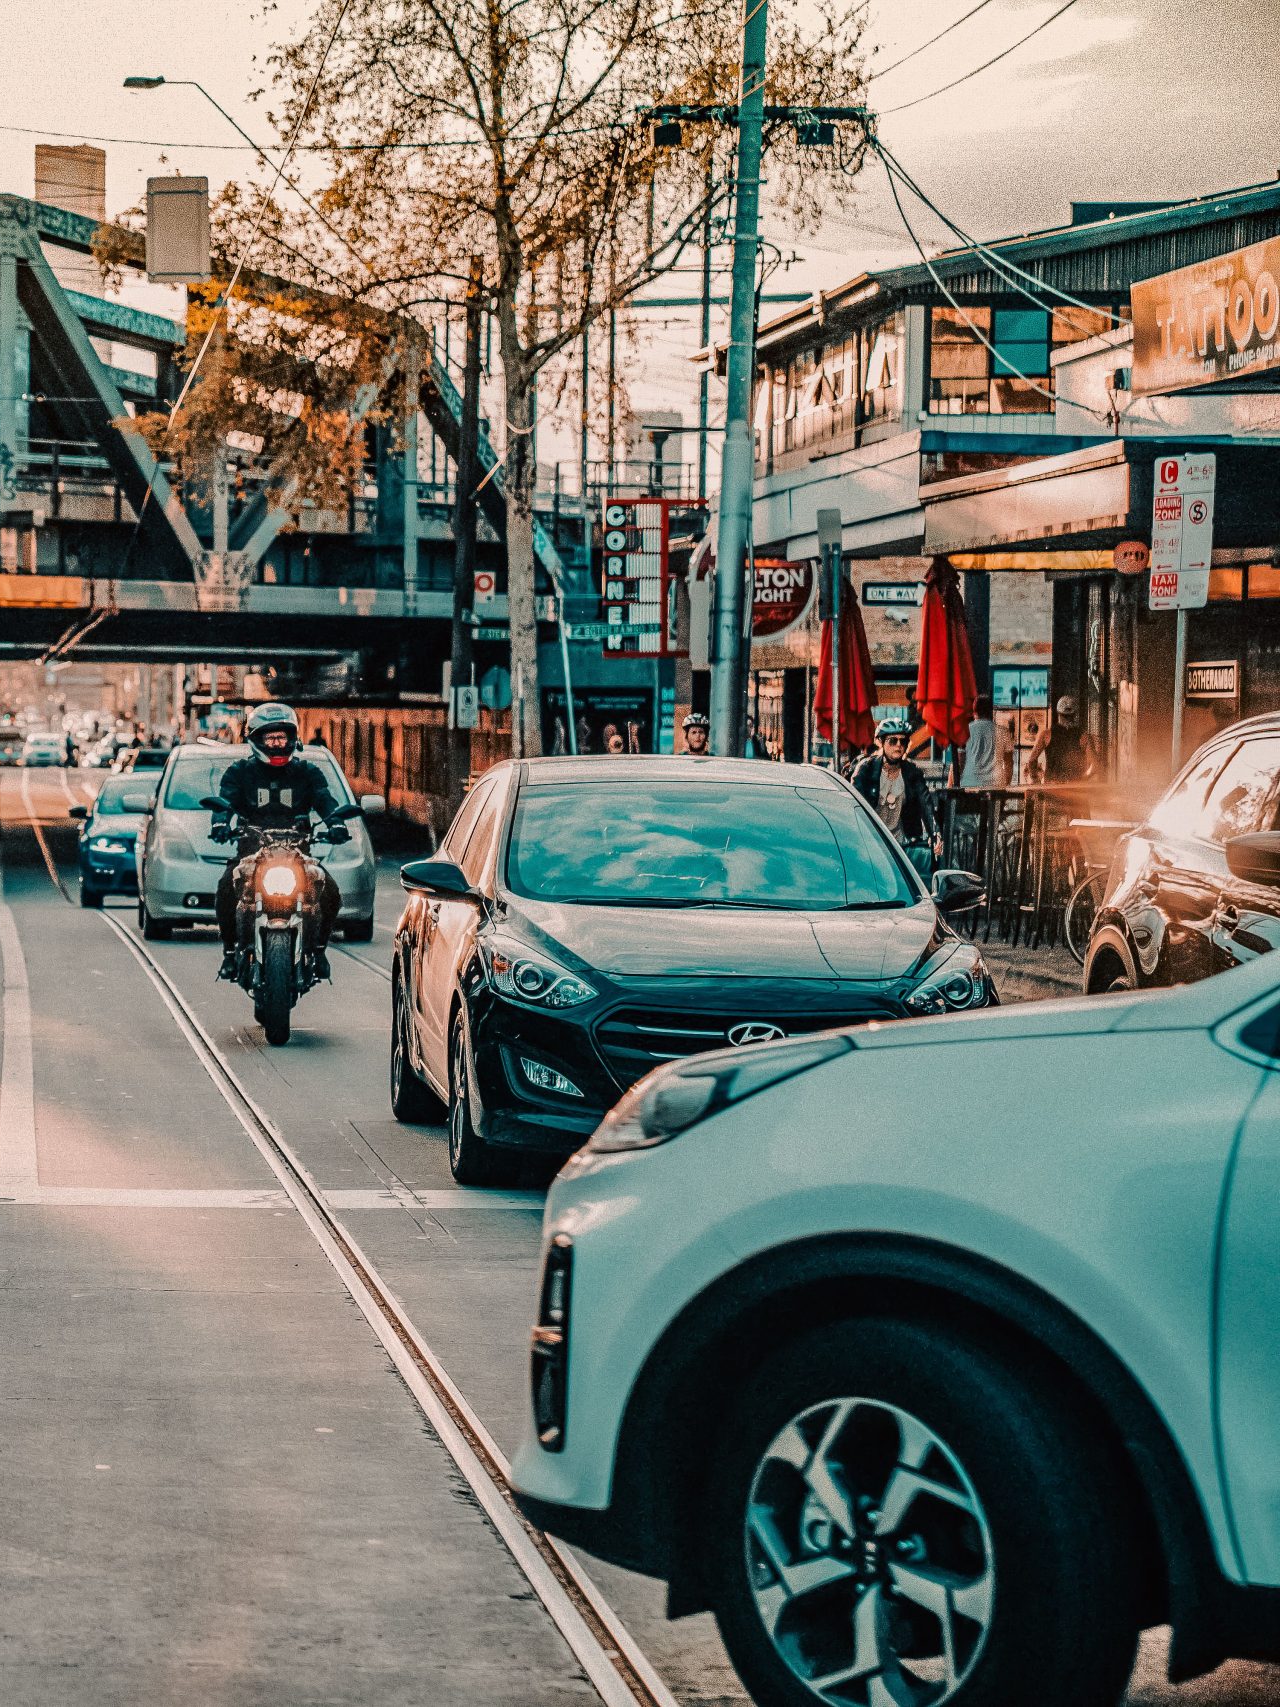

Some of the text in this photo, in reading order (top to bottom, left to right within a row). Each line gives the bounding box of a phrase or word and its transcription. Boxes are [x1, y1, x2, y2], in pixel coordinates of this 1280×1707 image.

[1156, 271, 1280, 361] TATTOO
[1155, 498, 1181, 509] LOADING
[1154, 509, 1181, 520] ZONE
[606, 505, 626, 650] CORNER
[745, 568, 805, 588] LTON
[1154, 574, 1176, 585] TAXI
[754, 588, 793, 602] UGHT
[871, 588, 916, 600] ONE WAY
[1151, 585, 1177, 596] ZONE
[1188, 668, 1234, 690] BOTHERAMBO
